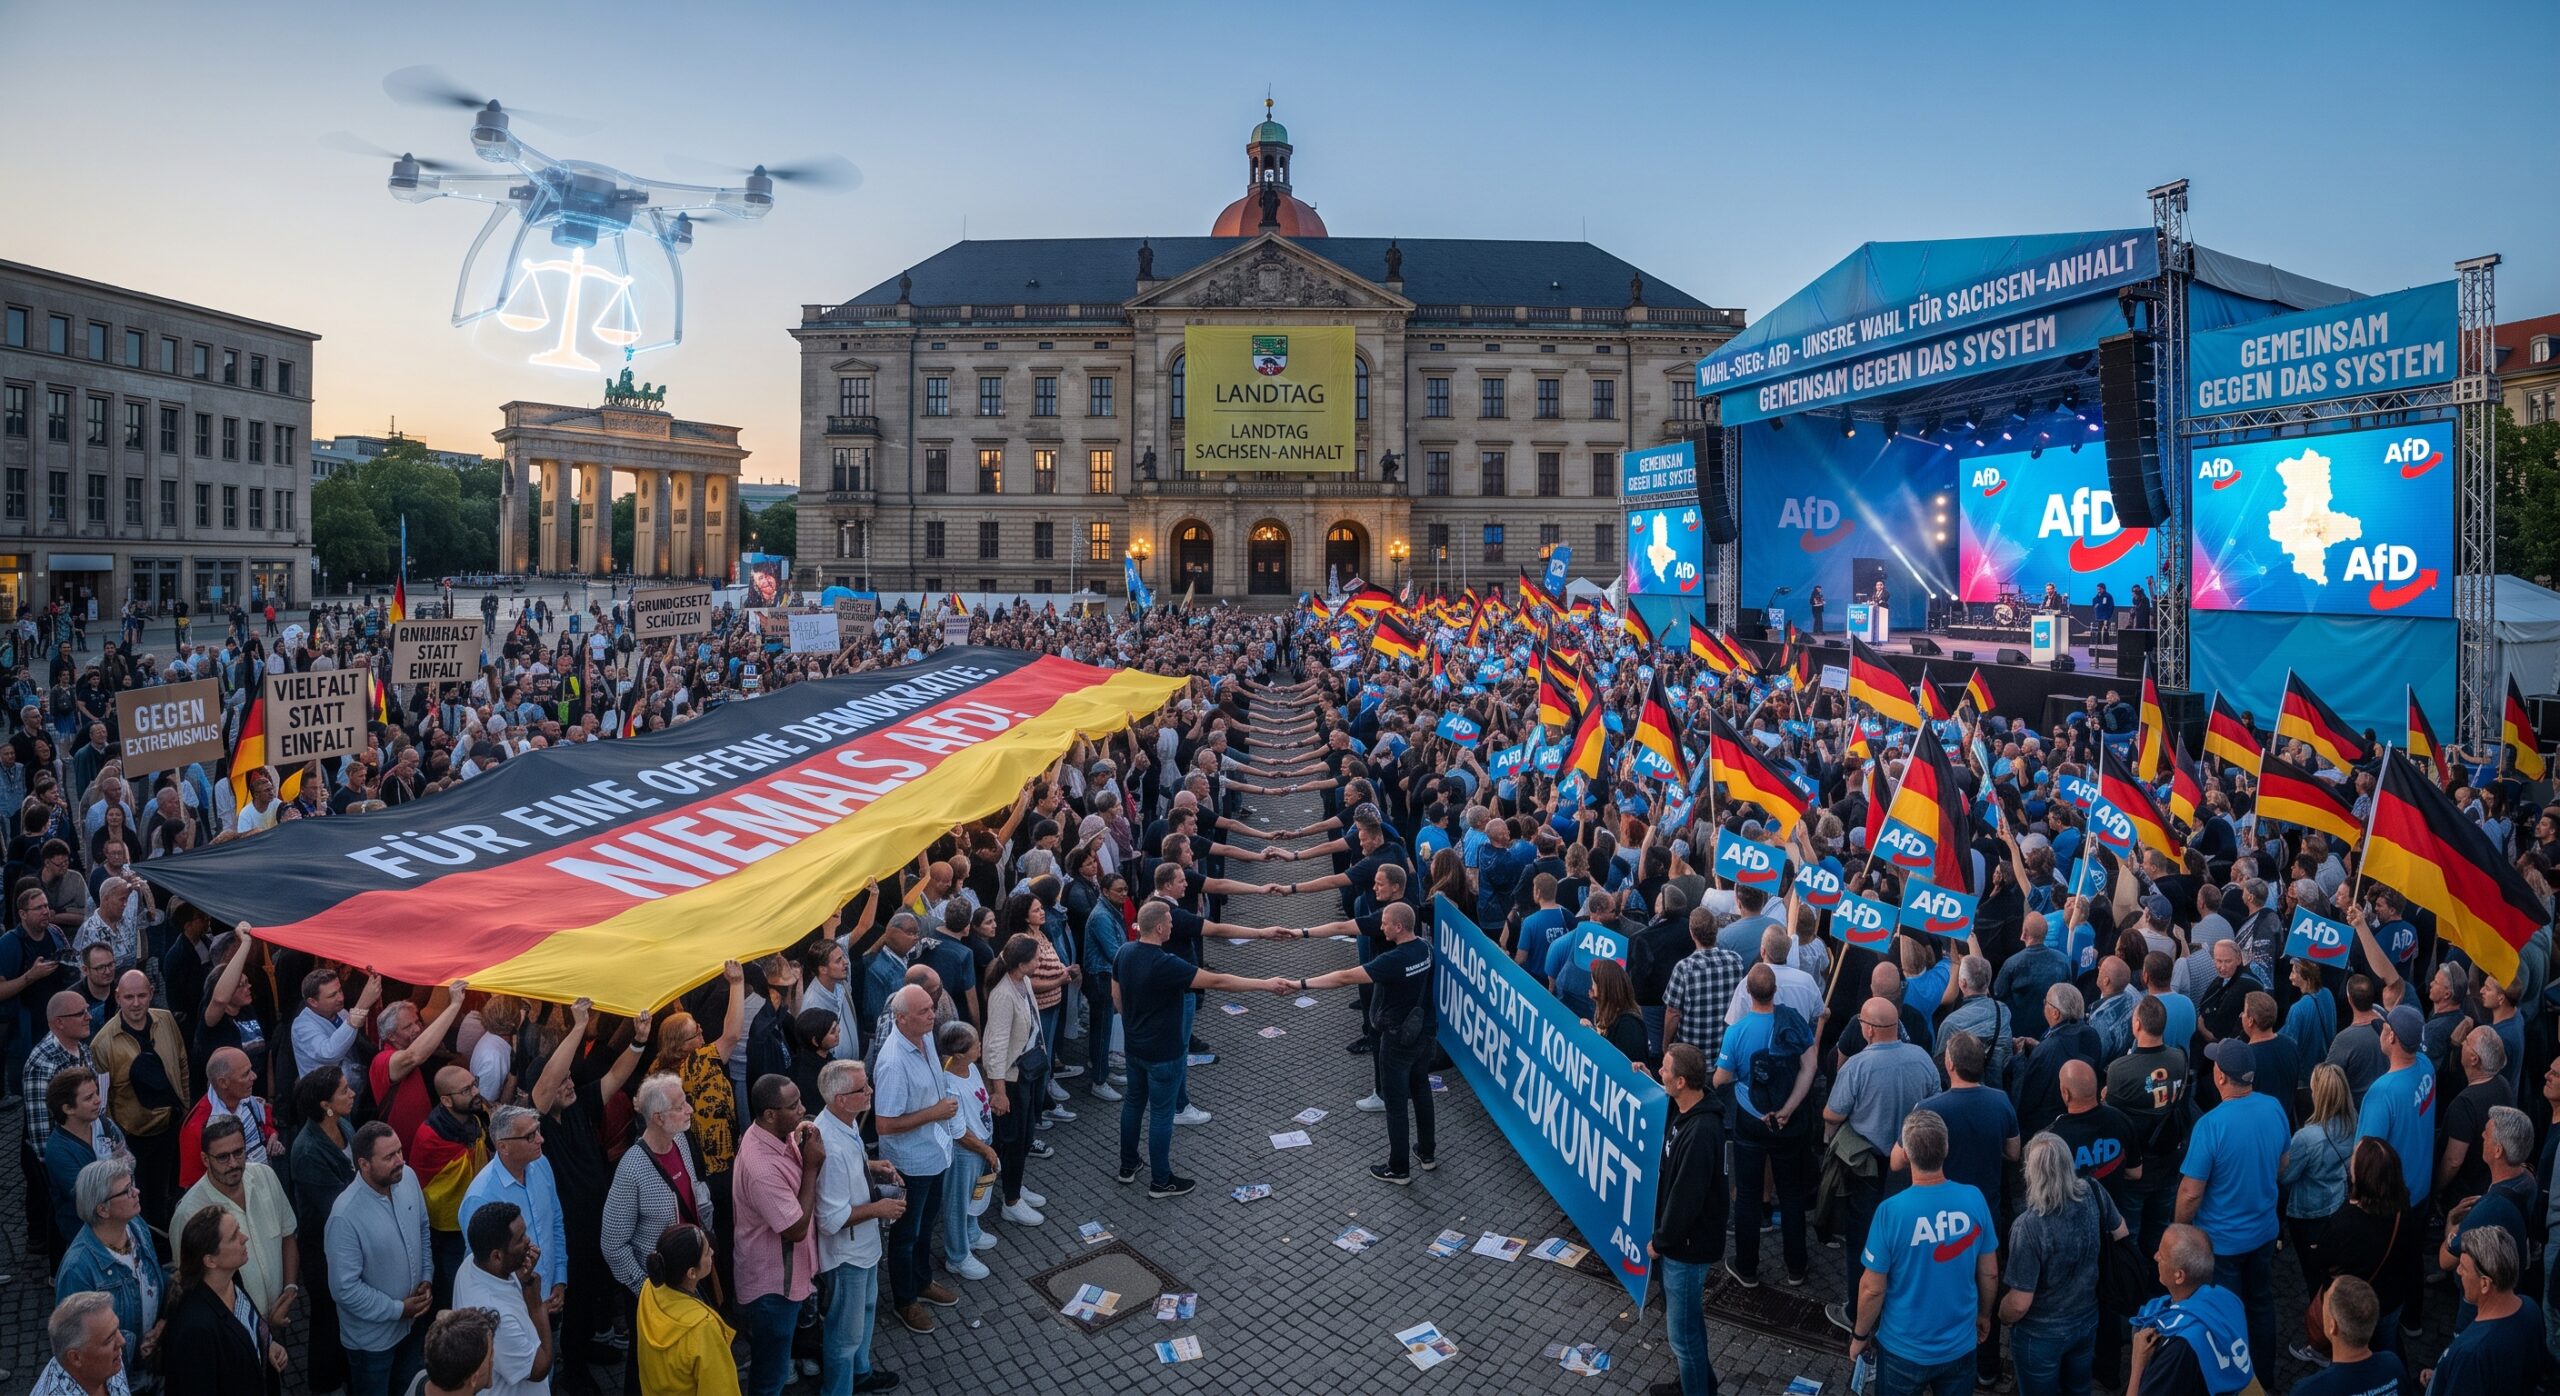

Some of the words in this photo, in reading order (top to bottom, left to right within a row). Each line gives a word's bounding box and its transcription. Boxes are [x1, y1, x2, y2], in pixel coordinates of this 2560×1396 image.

[1700, 352, 1765, 387] WAHL-SIEG:
[1802, 322, 1856, 359] UNSERE
[1860, 310, 1904, 342] WAHL
[1908, 293, 1942, 329] FÜR
[1946, 237, 2138, 319] SACHSEN-ANHALT
[2240, 312, 2389, 368] GEMEINSAM
[1759, 367, 1848, 412] GEMEINSAM
[1852, 351, 1911, 391] GEGEN
[1917, 340, 1957, 377] DAS
[1963, 315, 2056, 366] SYSTEM
[2199, 370, 2272, 409] GEGEN
[2280, 361, 2327, 396] DAS
[2335, 340, 2445, 388] SYSTEM
[1216, 383, 1325, 404] LANDTAG
[1231, 423, 1308, 440] LANDTAG
[1195, 443, 1344, 460] SACHSEN-ANHALT
[2384, 437, 2430, 465] AfD
[1652, 472, 1667, 488] DAS
[1972, 467, 2000, 488] AfD
[2198, 457, 2234, 480] AfD
[1777, 497, 1840, 529] AfD
[2037, 486, 2121, 539] AfD
[1674, 561, 1695, 580] AfD
[2343, 545, 2417, 583] AfD
[637, 593, 711, 612] GRUNDGESETZ
[646, 611, 701, 629] SCHÜTZEN
[417, 644, 458, 660] STATT
[409, 662, 463, 680] EINFALT
[274, 673, 359, 701] VIELFALT
[134, 698, 205, 733] GEGEN
[289, 702, 345, 729] STATT
[125, 724, 219, 757] EXTREMISMUS
[281, 727, 355, 757] EINFALT
[345, 824, 532, 879] FÜR
[500, 780, 664, 837] EINE
[637, 733, 811, 795] OFFENE
[545, 750, 927, 899] NIEMALS
[884, 701, 1035, 755] AFD!
[2095, 805, 2131, 840] AfD
[1721, 843, 1769, 871] AfD
[1880, 828, 1927, 857] AfD
[1795, 865, 1839, 893] AfD
[1833, 899, 1882, 929] AfD
[1909, 890, 1962, 919] AfD
[1578, 931, 1617, 958] AfD
[2294, 917, 2341, 947] AfD
[1440, 919, 1486, 994] DIALOG
[1489, 968, 1538, 1046] STATT
[1541, 1018, 1647, 1152] KONFLIKT:
[1439, 964, 1511, 1090] UNSERE
[1512, 1046, 1641, 1226] ZUKUNFT
[2074, 1138, 2122, 1170] AfD
[1610, 1225, 1641, 1264] AfD
[1910, 1211, 1971, 1248] AfD
